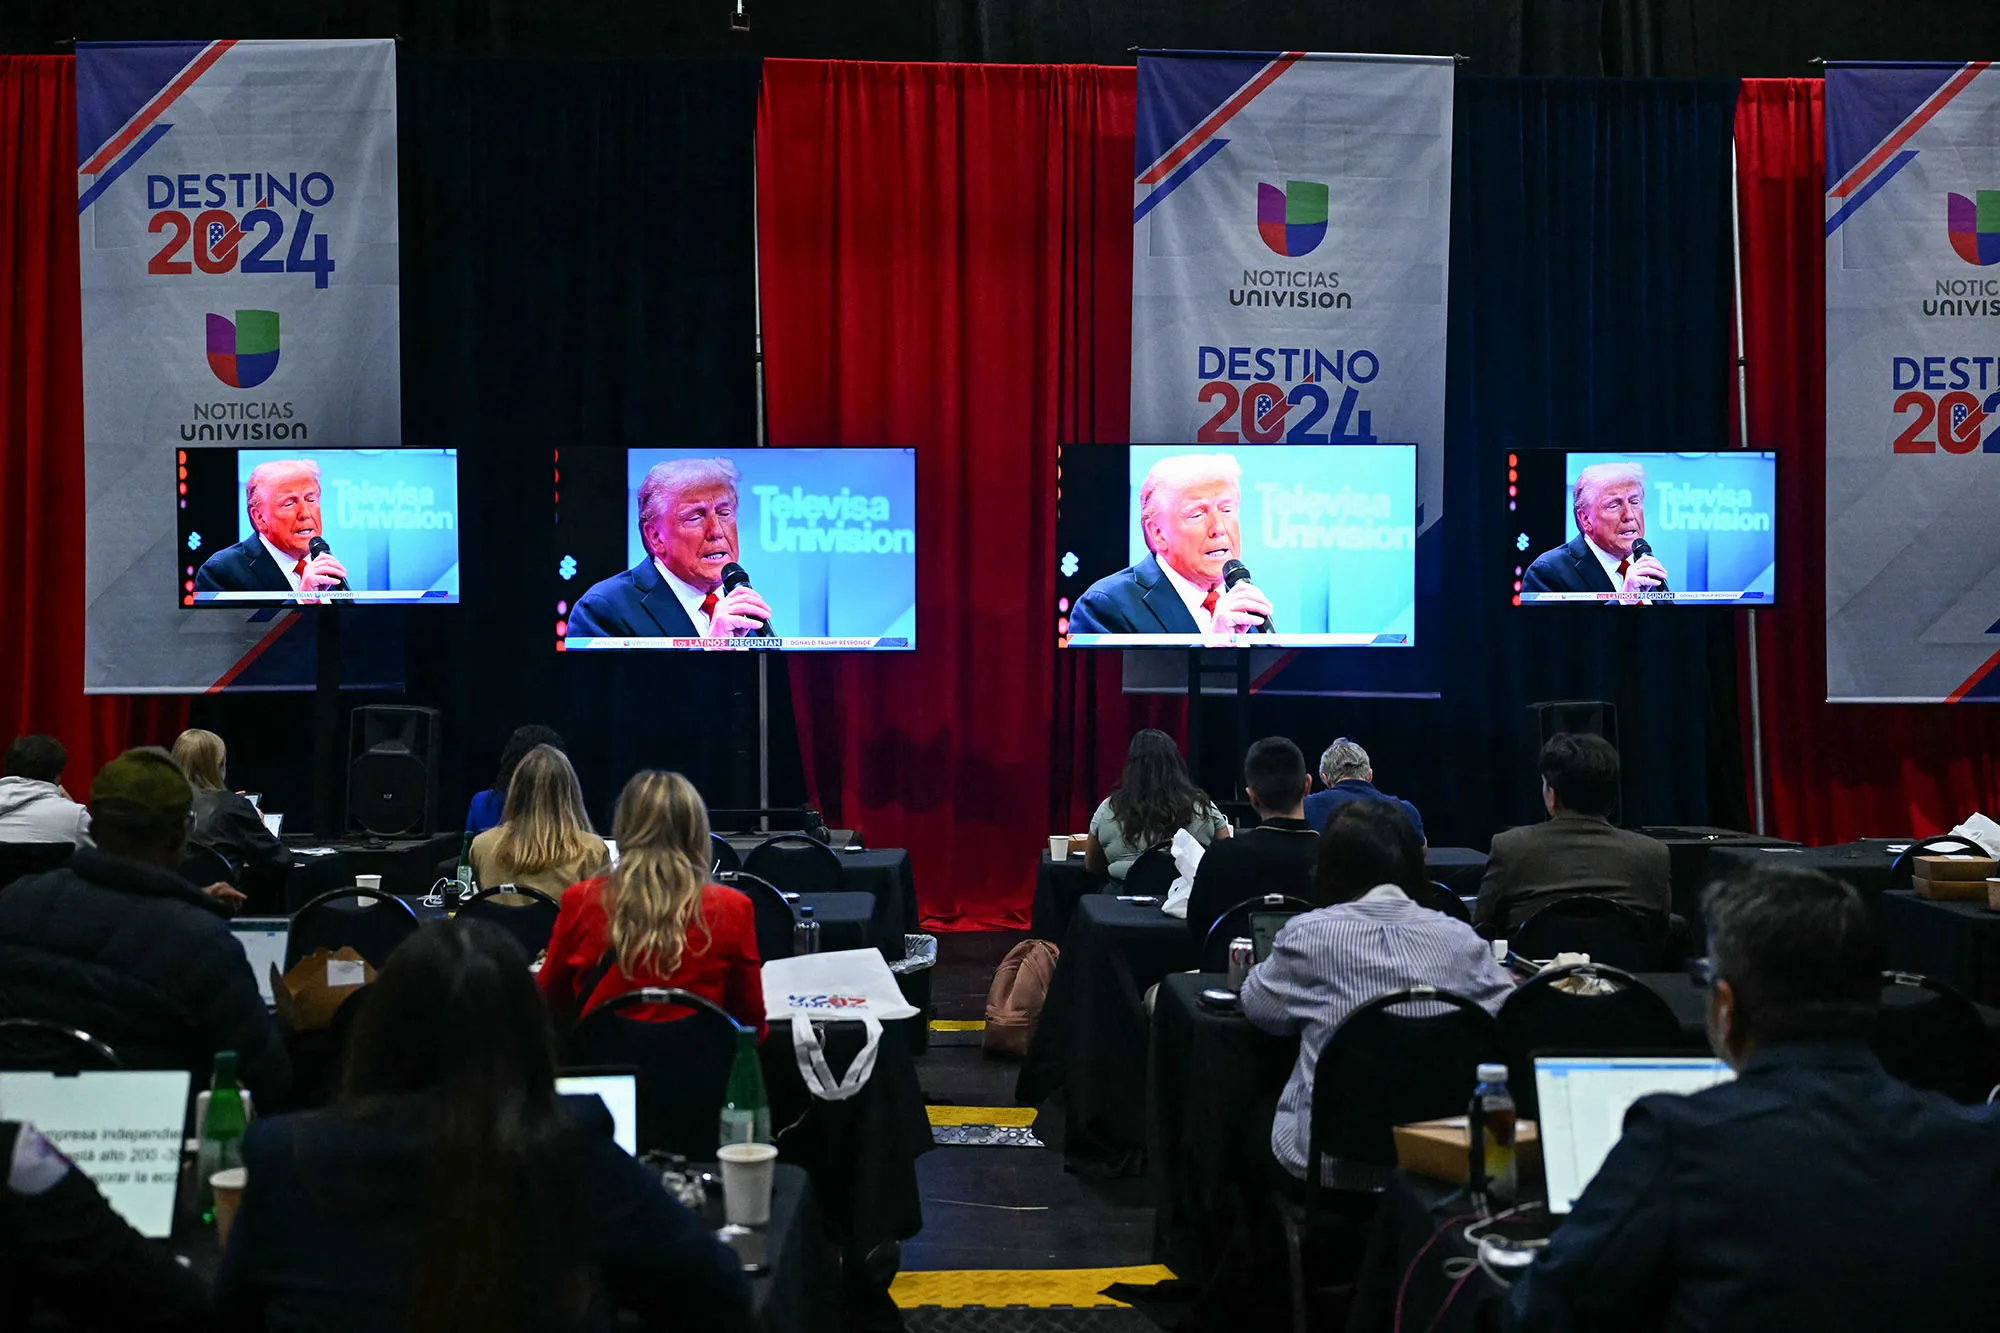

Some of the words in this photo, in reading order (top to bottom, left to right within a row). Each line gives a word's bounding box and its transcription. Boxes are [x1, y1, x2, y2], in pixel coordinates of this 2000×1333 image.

[147, 172, 335, 209] DESTINO
[148, 209, 335, 289] 2024
[1243, 270, 1339, 288] NOTICIAS
[1936, 280, 1998, 297] NOTIC
[1198, 346, 1380, 384] DESTINO
[194, 402, 294, 420] NOTICIAS
[1197, 381, 1377, 444] 2024
[332, 479, 434, 506] Televisa
[752, 485, 890, 521] Televisa
[1254, 482, 1391, 517] Televisa
[1654, 482, 1752, 508] Televisa
[338, 504, 454, 530] Univision
[1262, 515, 1415, 549] Univision
[1660, 506, 1770, 531] Univision
[760, 519, 915, 554] Univision
[689, 639, 727, 647] LATINOS
[728, 639, 782, 647] PREGUNTAN
